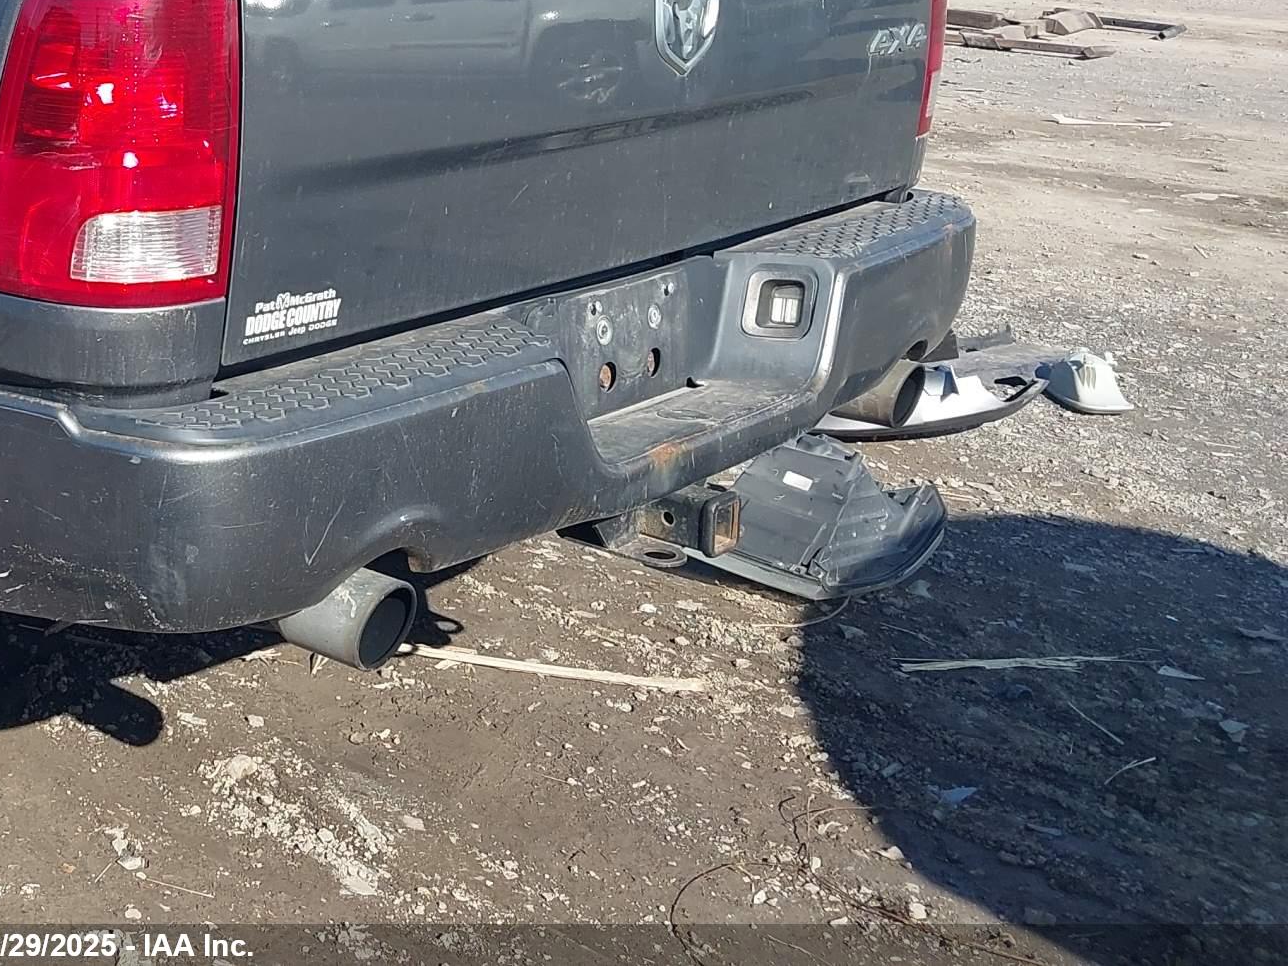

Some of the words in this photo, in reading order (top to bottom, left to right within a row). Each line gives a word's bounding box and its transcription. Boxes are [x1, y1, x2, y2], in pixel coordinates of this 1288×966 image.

[255, 301, 276, 314] Pat
[289, 288, 337, 307] McGrath
[245, 309, 287, 337] DODGE
[286, 298, 342, 328] COUNTRY
